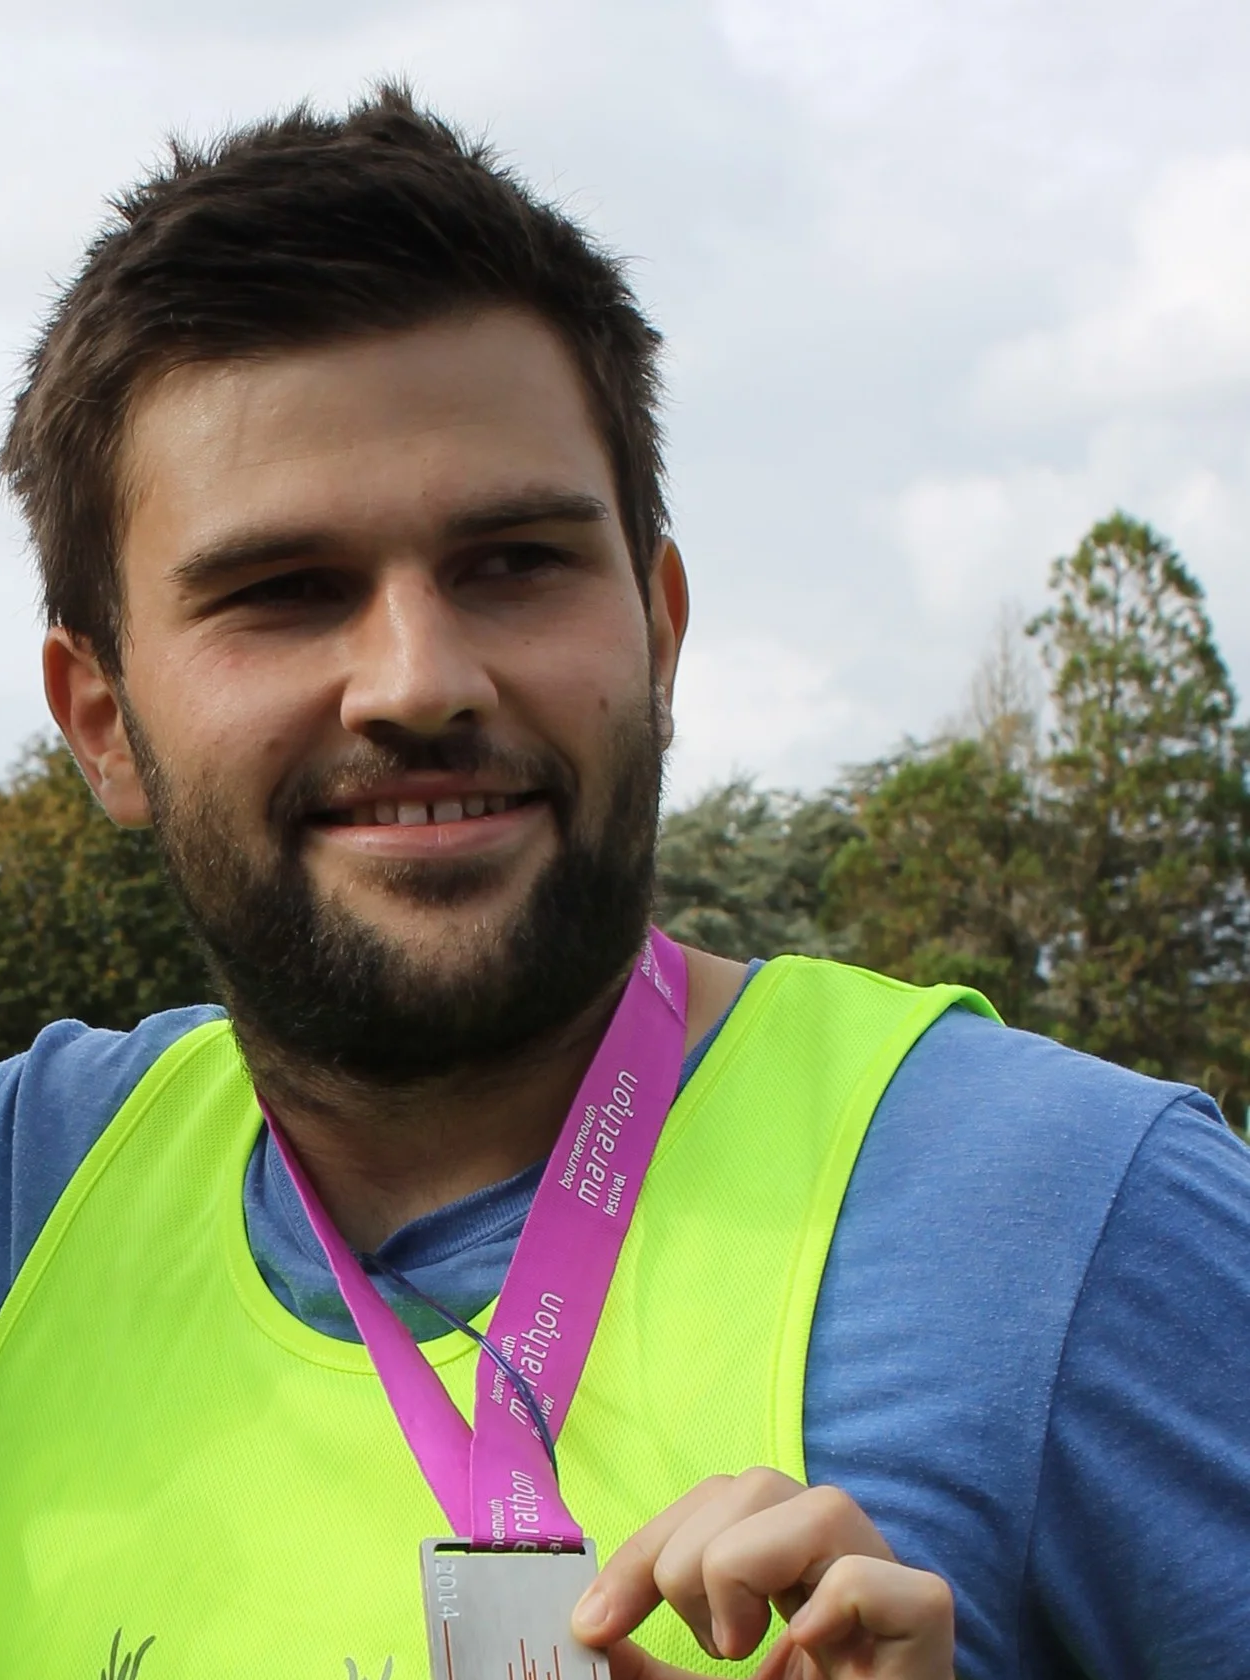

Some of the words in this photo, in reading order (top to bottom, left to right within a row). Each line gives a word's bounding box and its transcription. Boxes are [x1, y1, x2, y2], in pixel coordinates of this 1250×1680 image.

[558, 1104, 598, 1191] bournemouth
[602, 1172, 628, 1218] festival
[434, 1559, 460, 1619] 2014
